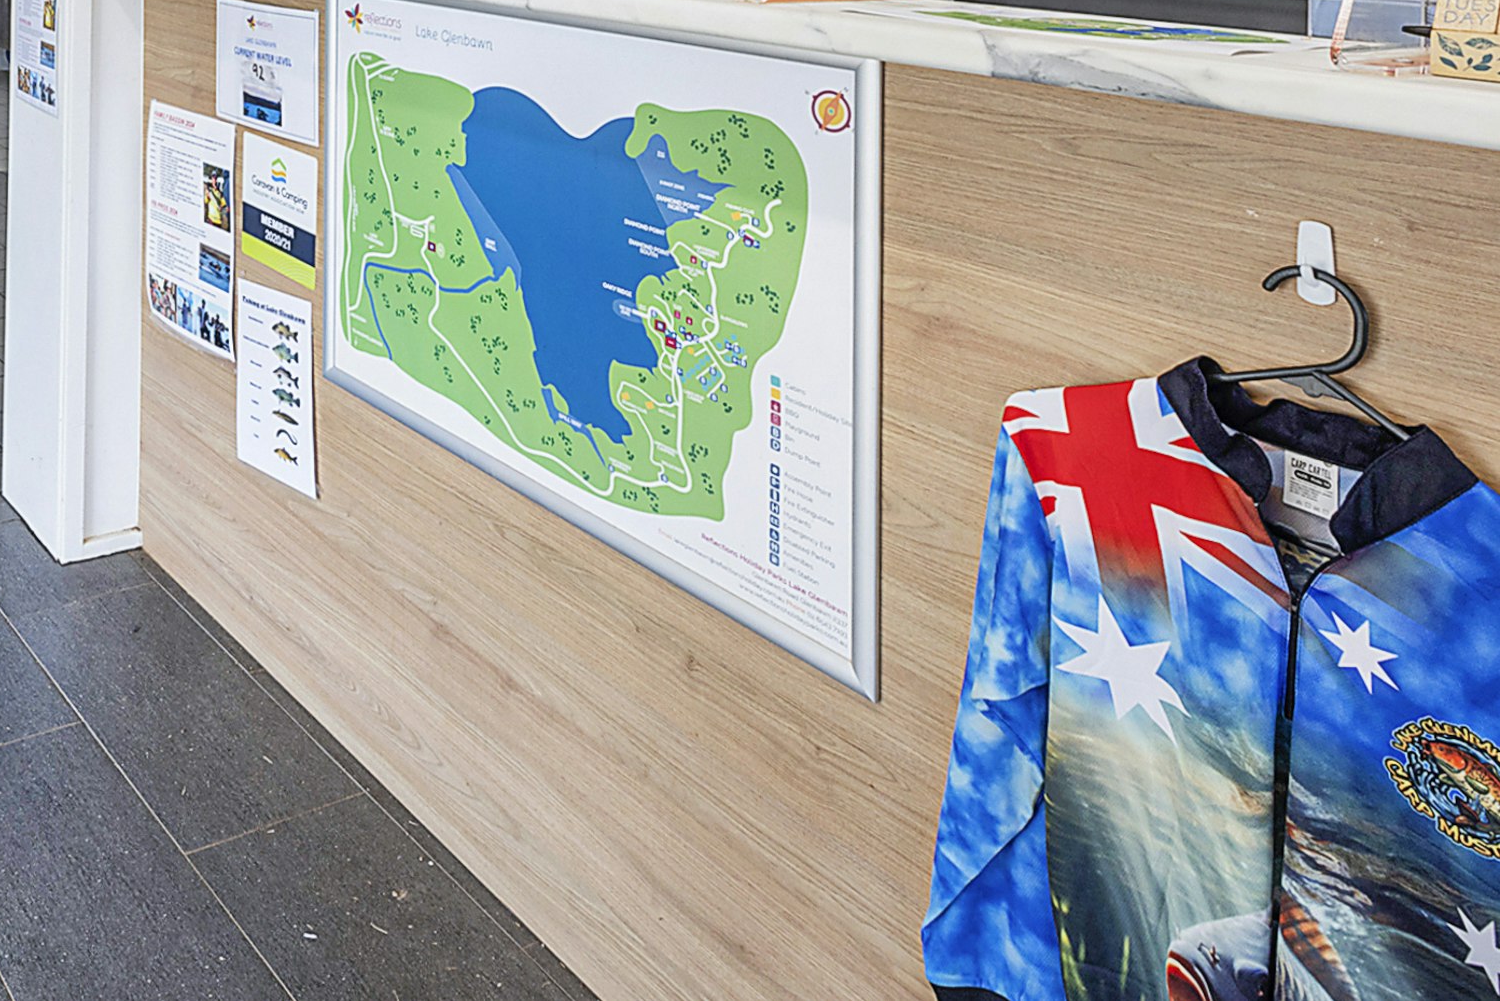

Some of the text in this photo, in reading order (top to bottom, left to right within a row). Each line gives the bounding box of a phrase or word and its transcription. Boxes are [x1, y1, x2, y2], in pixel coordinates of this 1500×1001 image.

[1444, 10, 1490, 25] DAY
[415, 25, 493, 51] Lake Glenbawn
[251, 175, 275, 193] Caravan
[281, 188, 308, 210] Camping
[260, 215, 295, 239] MEMBER
[1392, 723, 1422, 751] LAKE
[1385, 759, 1435, 818] CARP
